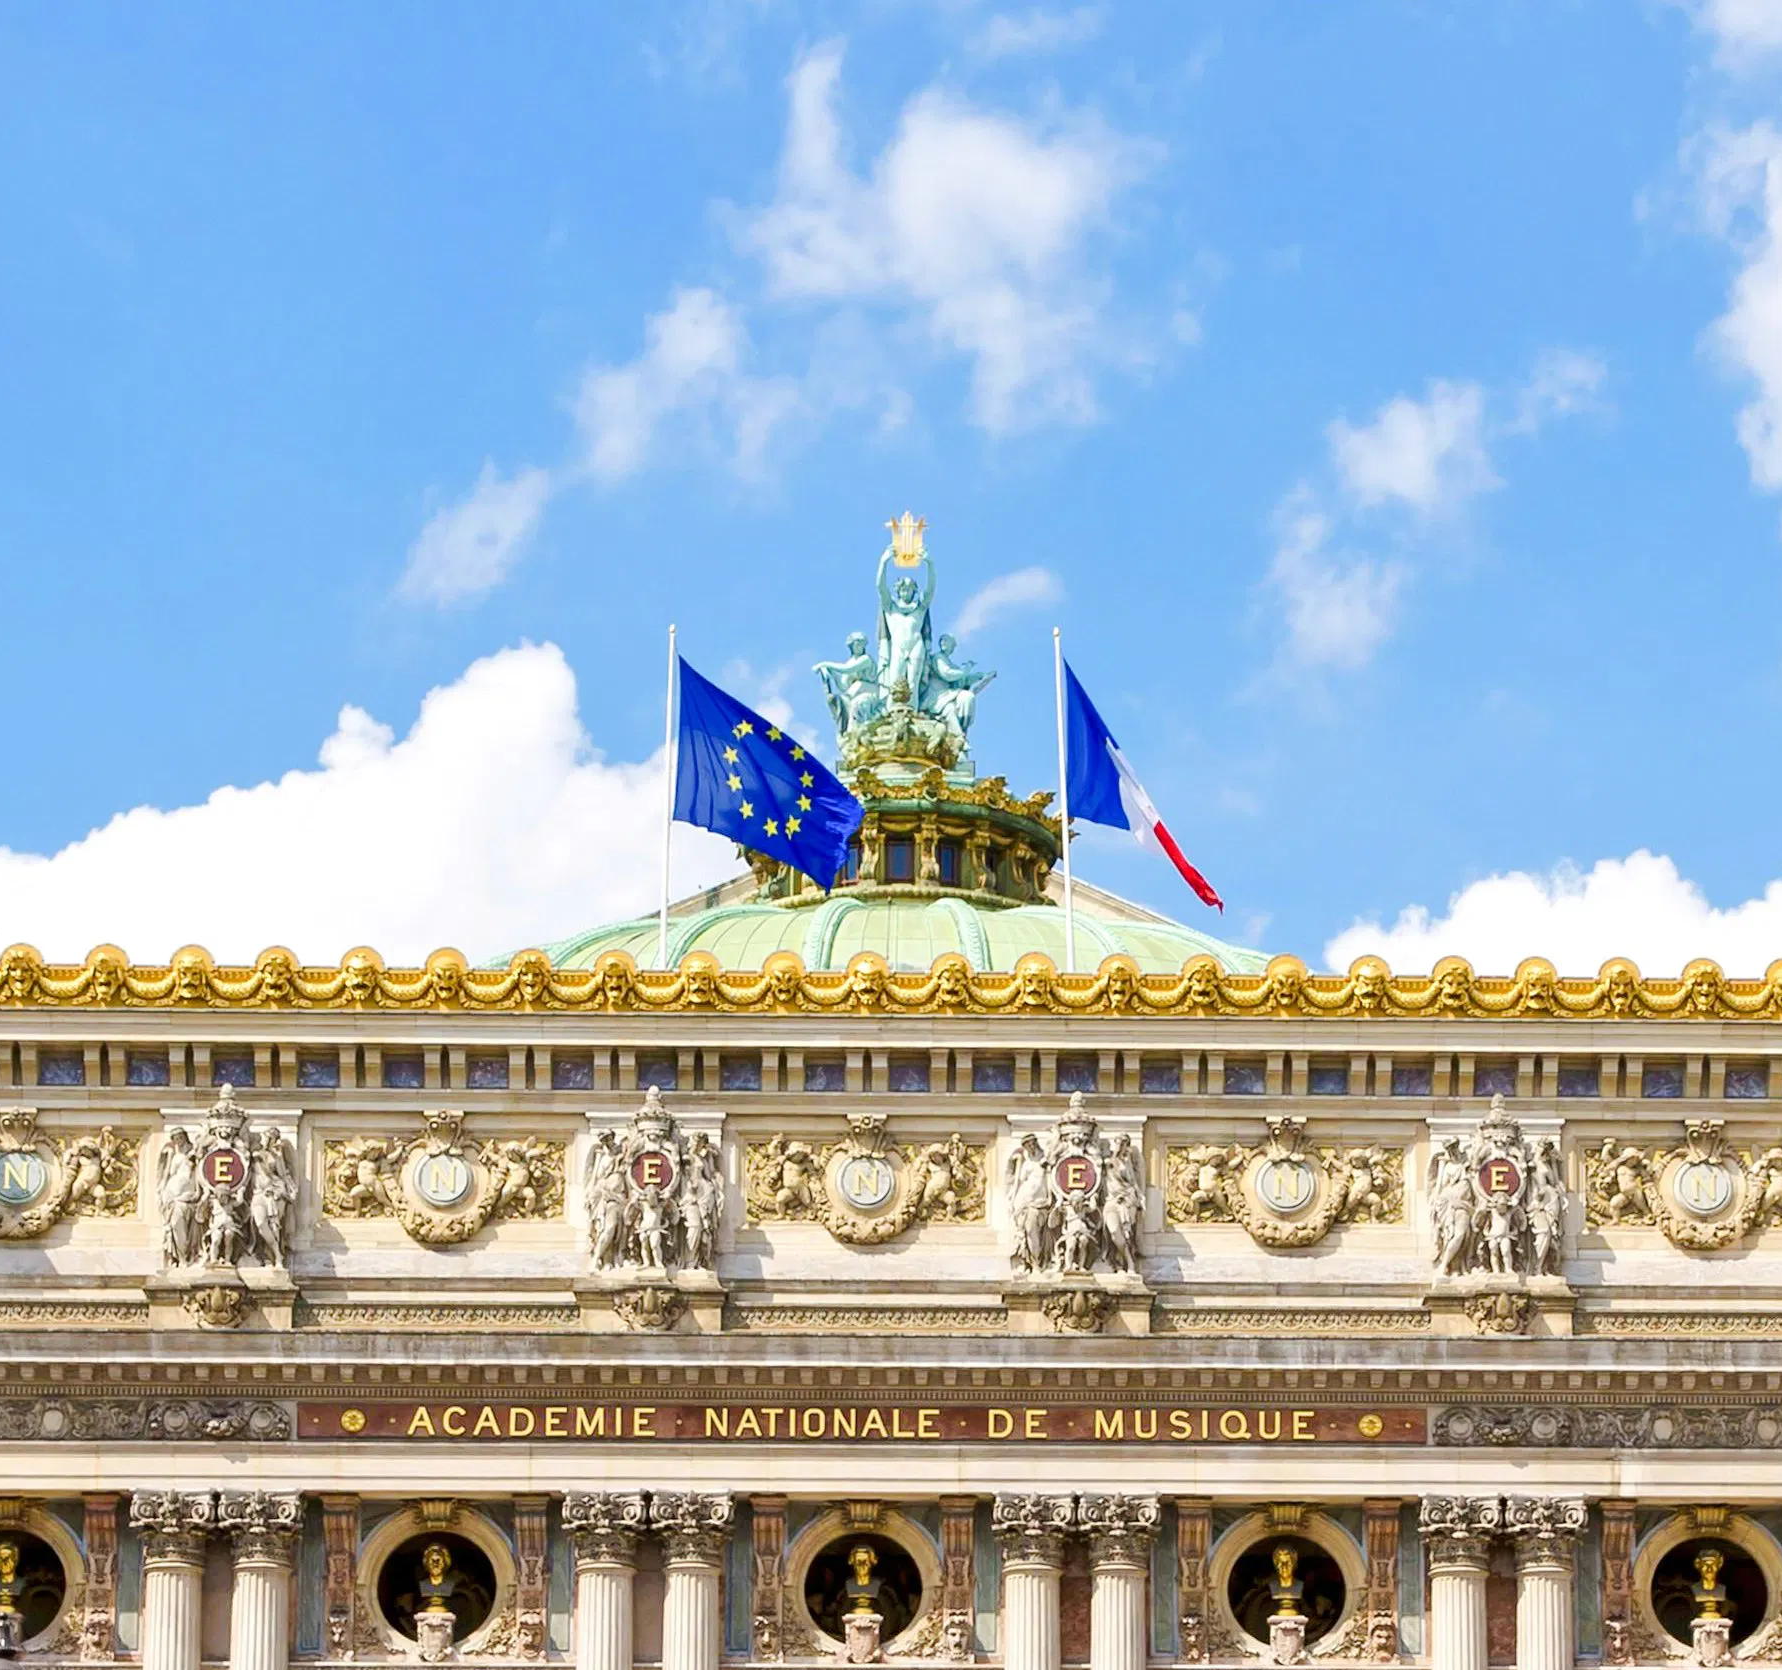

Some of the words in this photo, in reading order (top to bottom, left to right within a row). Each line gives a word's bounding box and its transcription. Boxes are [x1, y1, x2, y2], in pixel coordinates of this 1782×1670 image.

[2, 1161, 31, 1191] N
[214, 1157, 233, 1182] E
[427, 1163, 458, 1194] N
[643, 1159, 662, 1185] E
[853, 1167, 880, 1197] N
[1067, 1163, 1087, 1189] E
[1274, 1169, 1299, 1199] N
[1490, 1166, 1510, 1192] E
[1693, 1172, 1718, 1203] N
[407, 1406, 657, 1437] ACADEMIE
[704, 1407, 941, 1438] NATIONALE
[987, 1408, 1049, 1439] DE
[1094, 1409, 1316, 1442] MUSIQUE
